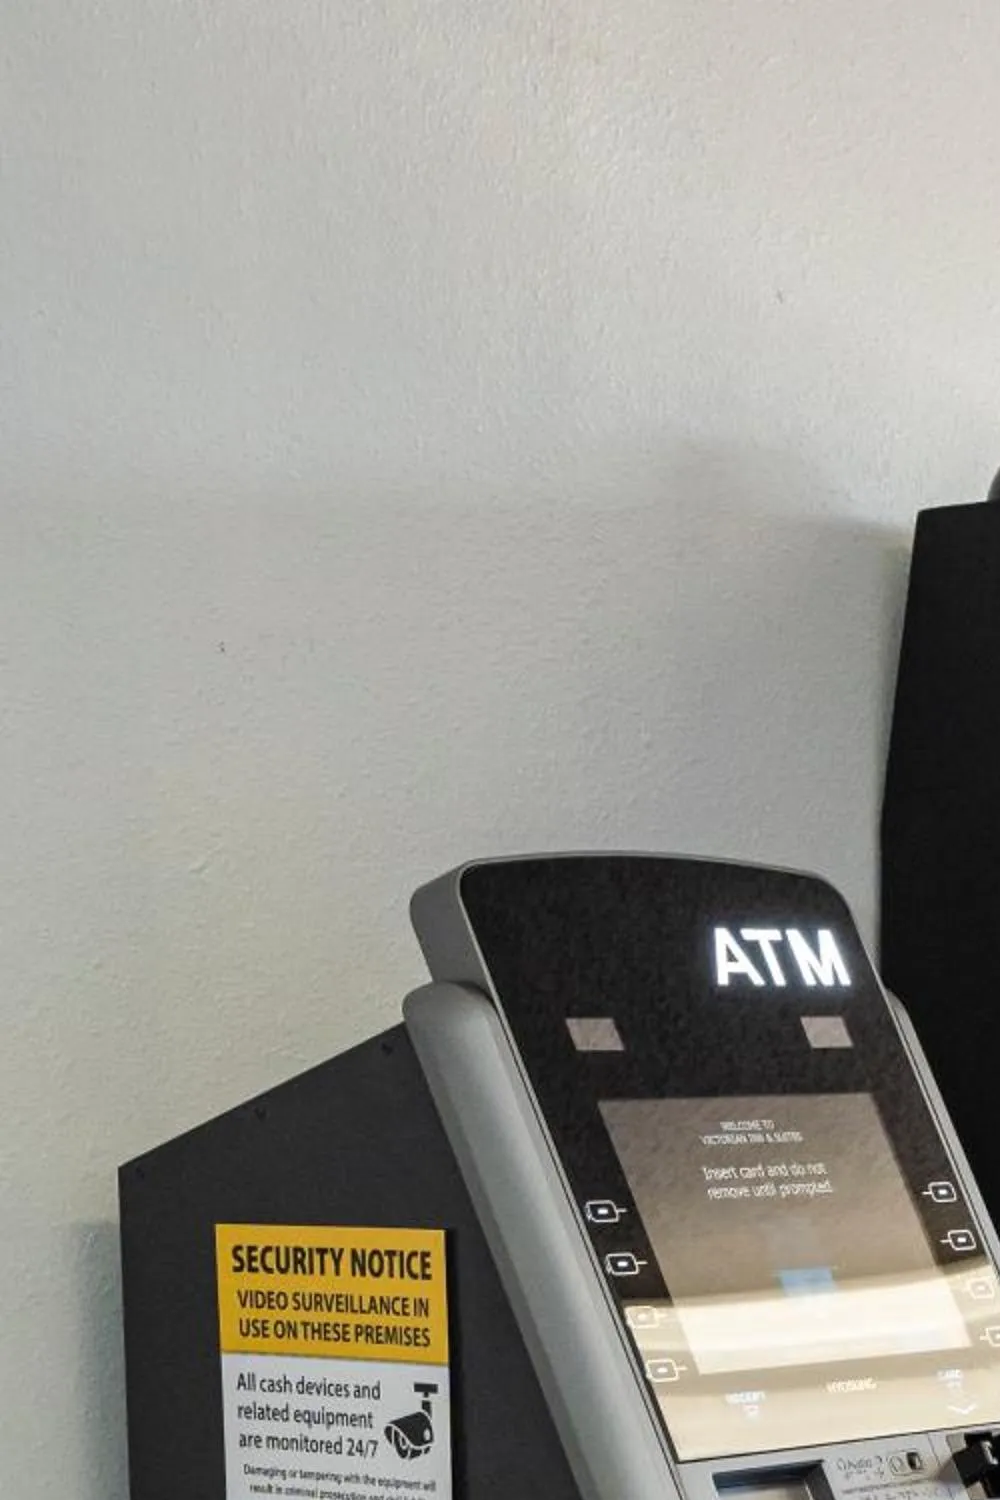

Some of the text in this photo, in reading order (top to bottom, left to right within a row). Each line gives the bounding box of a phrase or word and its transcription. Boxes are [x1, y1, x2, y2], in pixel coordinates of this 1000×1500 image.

[714, 927, 852, 987] ATM
[702, 1167, 738, 1181] Insert
[740, 1163, 765, 1179] card
[767, 1163, 789, 1177] and
[790, 1163, 805, 1176] do
[707, 1186, 751, 1199] remove
[752, 1183, 777, 1197] until
[231, 1245, 432, 1281] SECURITY NOTICE
[237, 1290, 429, 1317] VIDEO SURVEILLANCE IN
[239, 1320, 431, 1348] USE ON THESE PREMISES
[236, 1373, 381, 1400] All cash devices and
[237, 1402, 373, 1431] related equipment
[239, 1432, 378, 1458] are monitored 24/7
[243, 1463, 436, 1492] Damaging or tampering with the equipment will
[250, 1483, 272, 1494] result
[275, 1486, 283, 1494] in
[285, 1486, 318, 1499] criminal
